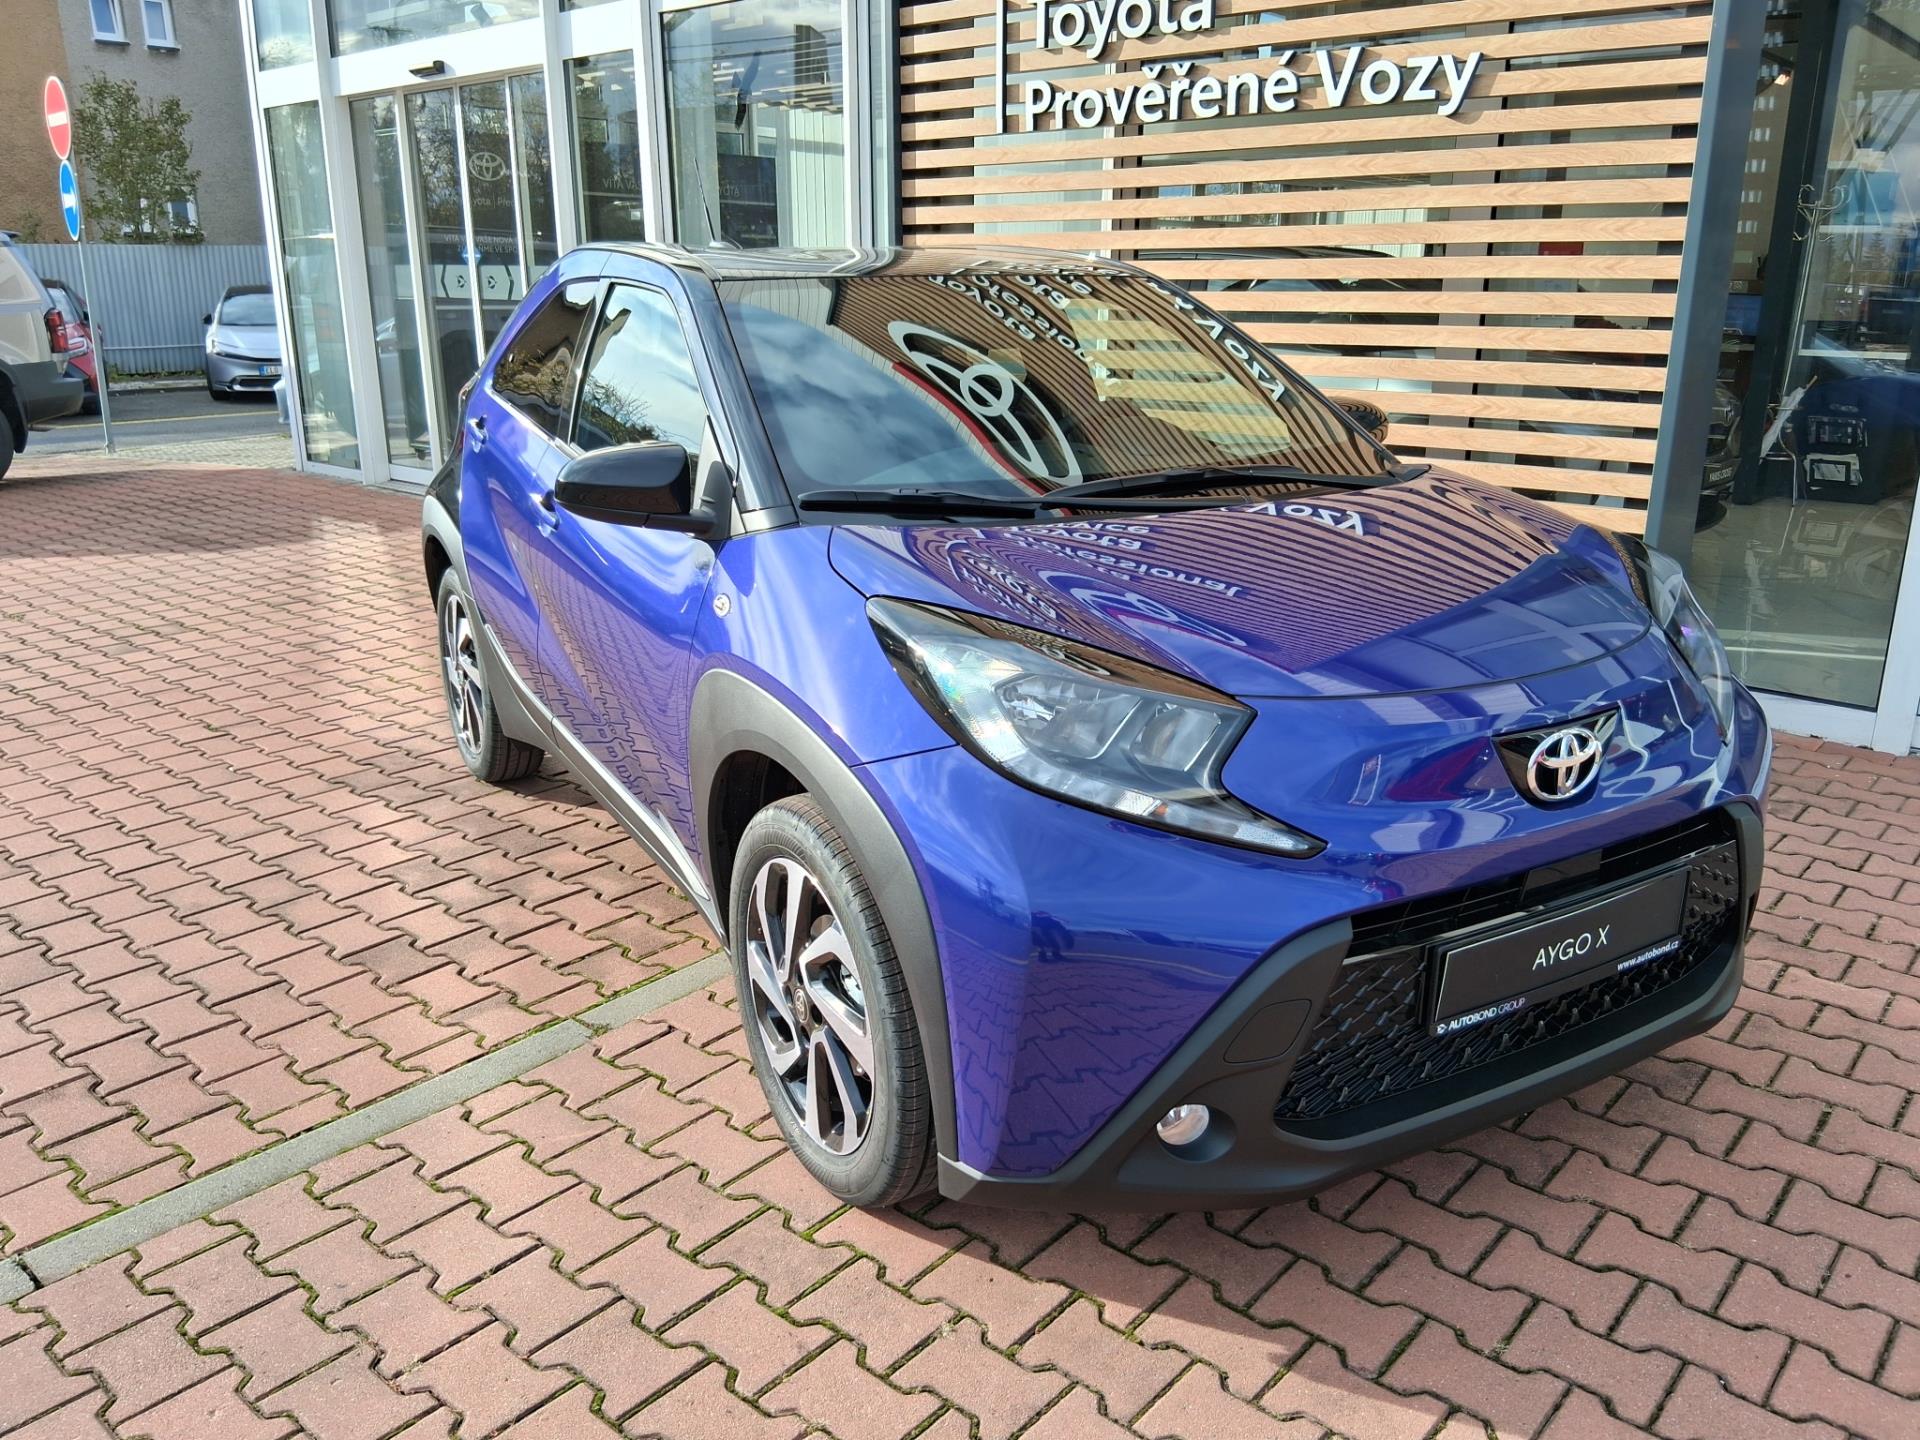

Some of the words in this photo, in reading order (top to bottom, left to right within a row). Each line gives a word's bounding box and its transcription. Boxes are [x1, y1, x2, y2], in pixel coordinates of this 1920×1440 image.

[1025, 50, 1298, 132] Prověřené
[1316, 46, 1483, 116] Vozy
[1532, 932, 1592, 971] AYGO
[1595, 924, 1610, 949] X
[1617, 940, 1680, 972] www.autobond.cz
[1448, 1007, 1498, 1031] AUTOBOND
[1498, 997, 1526, 1014] GROUP
